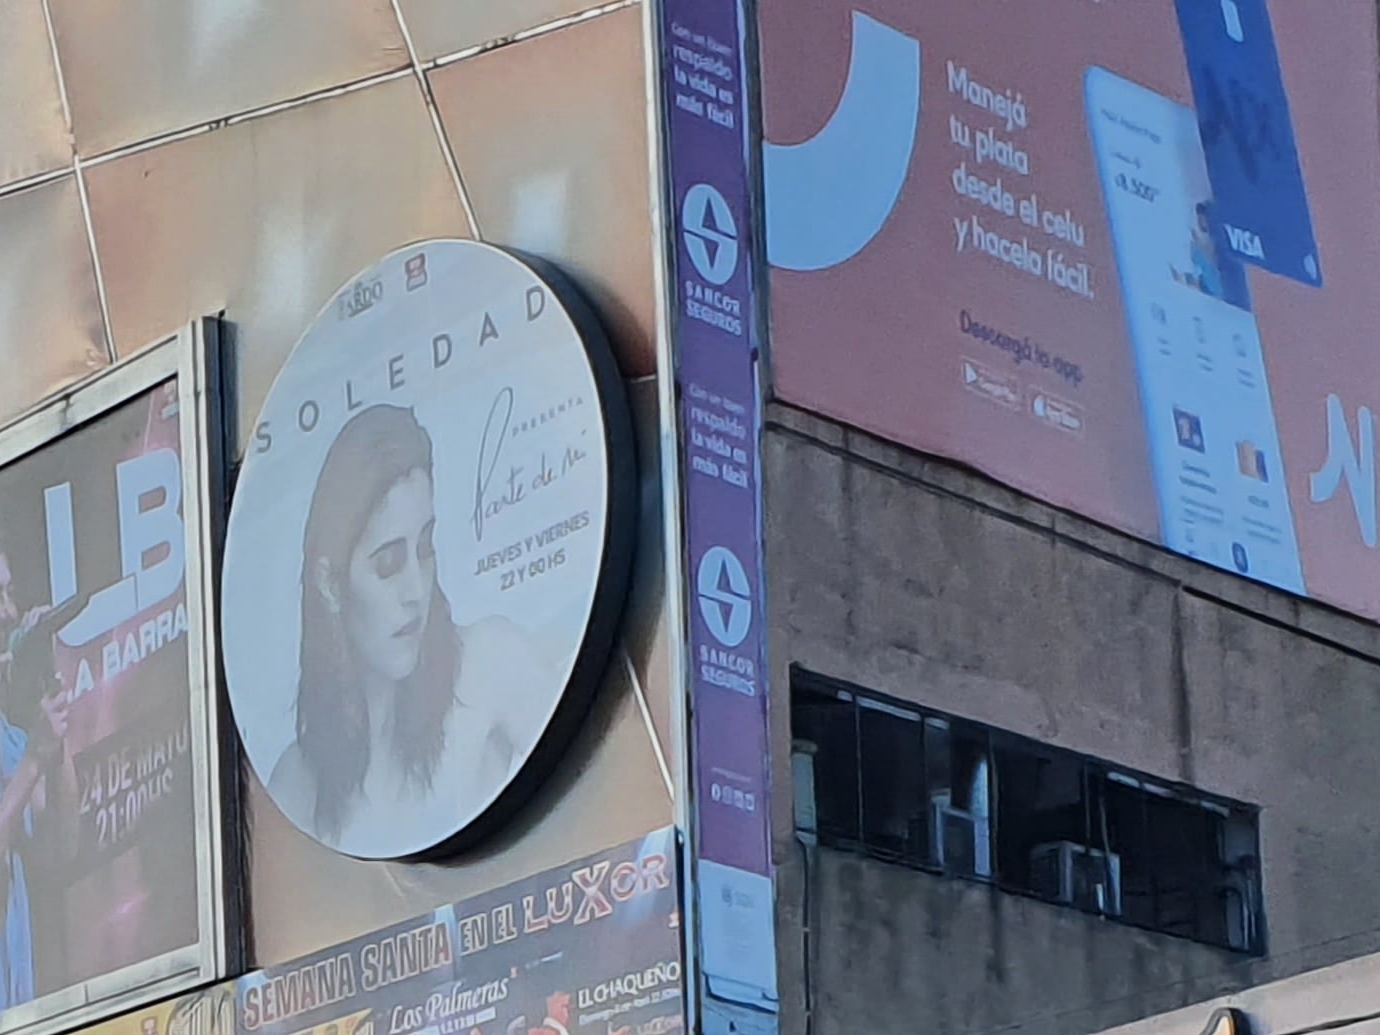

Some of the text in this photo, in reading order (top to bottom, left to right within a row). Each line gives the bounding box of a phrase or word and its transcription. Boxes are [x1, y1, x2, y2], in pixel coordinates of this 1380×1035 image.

[946, 60, 1027, 131] Manejá
[950, 113, 1029, 175] tu plata
[952, 161, 1084, 247] desde el celu
[954, 217, 968, 252] y
[972, 215, 1042, 276] hacela
[1223, 223, 1266, 260] VISA
[685, 281, 741, 315] SANCOR
[686, 300, 742, 336] SEGUROS
[254, 286, 546, 455] SOLEDAD
[474, 510, 591, 576] JUEVES Y VIERNES
[500, 568, 516, 592] 22
[516, 562, 527, 583] Y
[103, 602, 190, 683] BARRA
[700, 644, 755, 678] SANCOR
[243, 952, 356, 1031] SEMANA
[360, 922, 453, 992] SANTA
[459, 912, 488, 957] EN
[492, 902, 518, 945] EL
[522, 854, 671, 934] LUXOR
[388, 1005, 423, 1035] Los
[425, 977, 509, 1022] Palmeras
